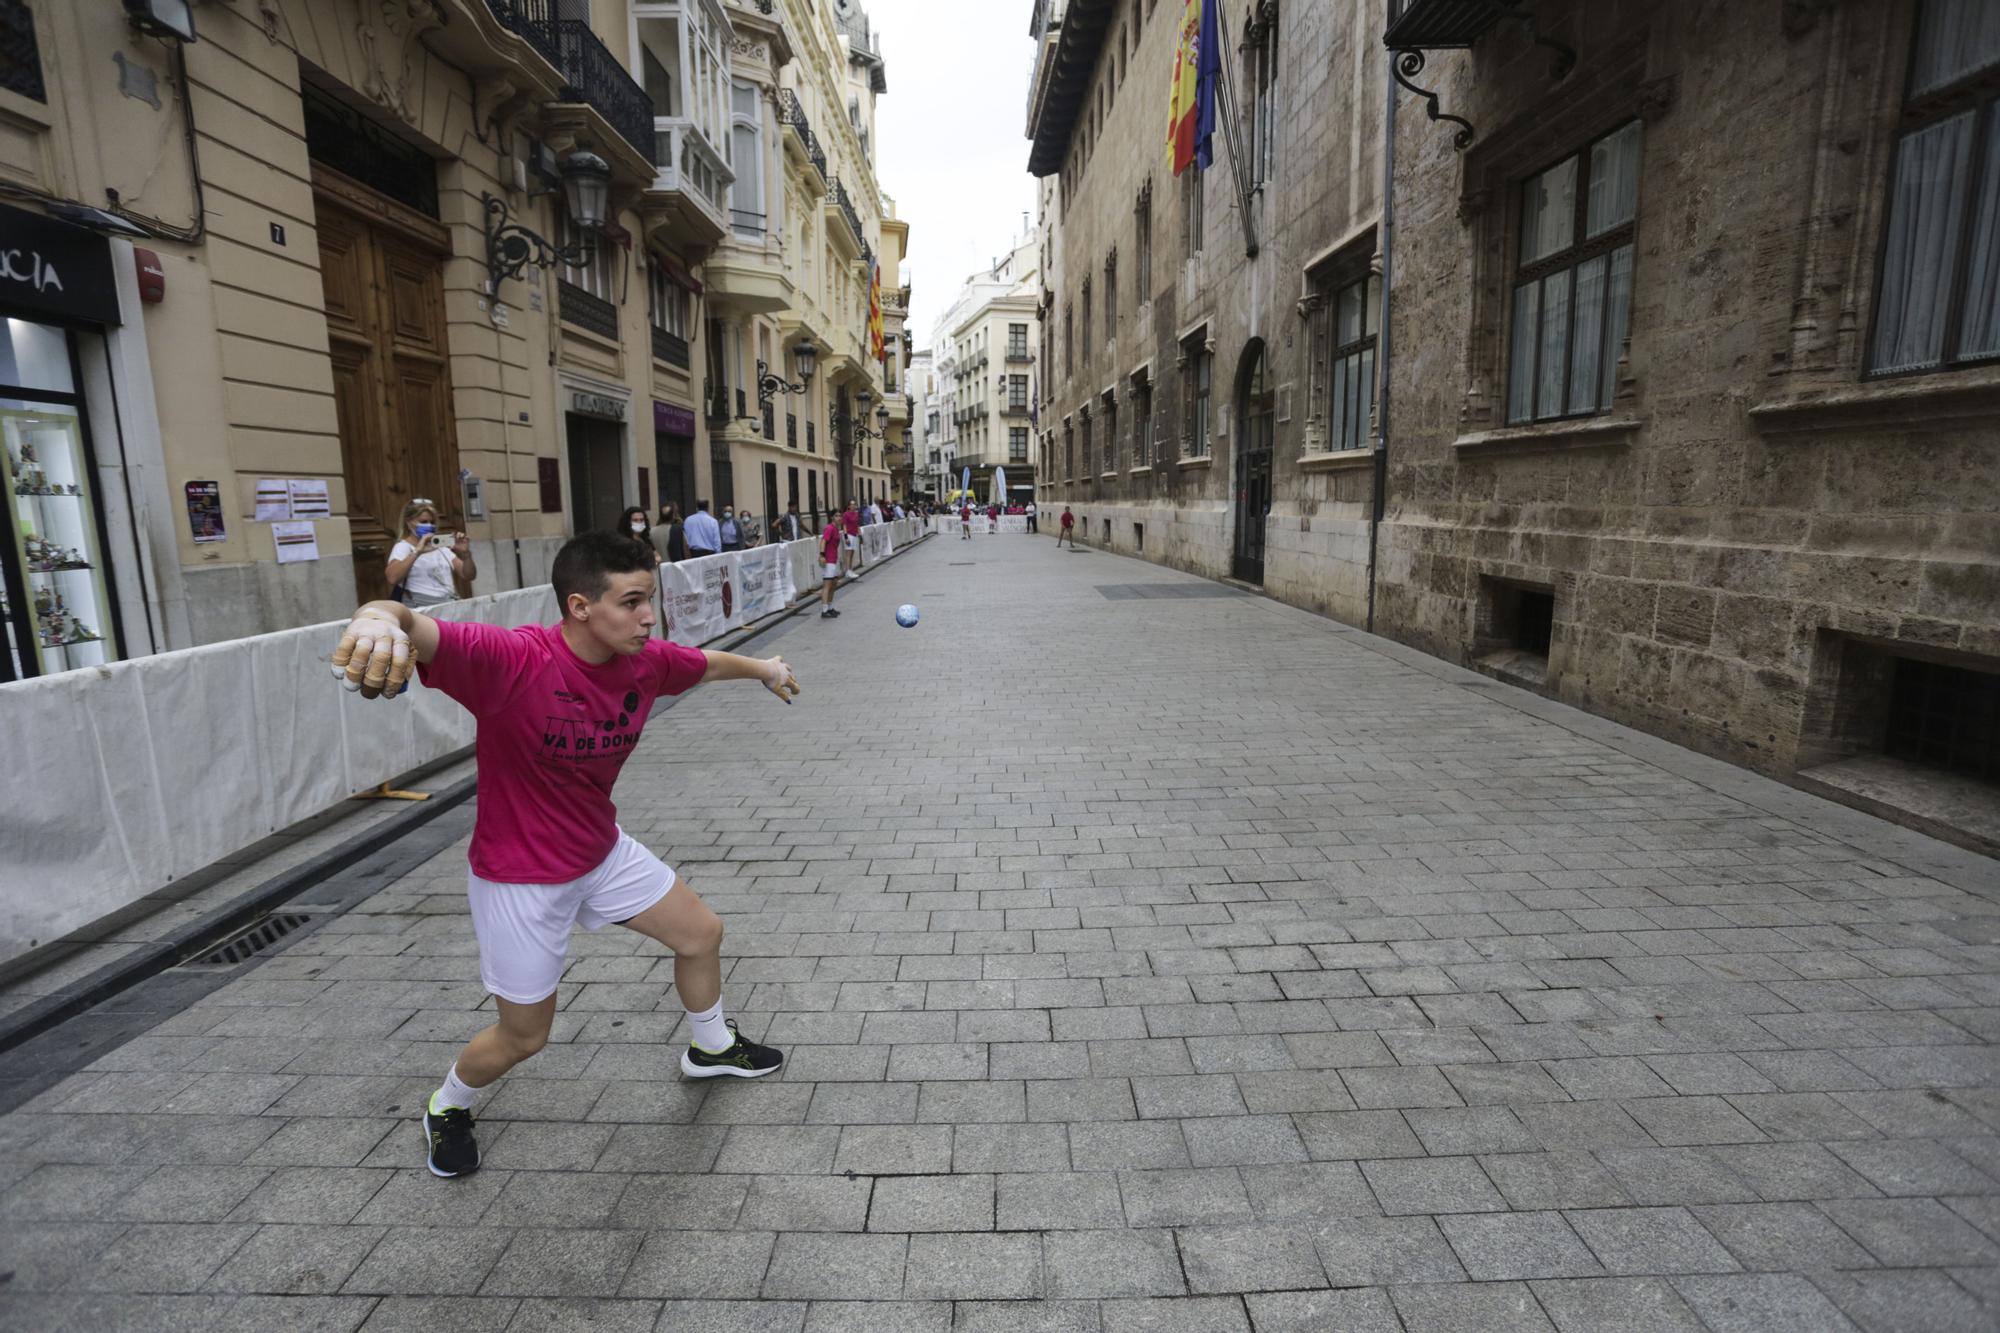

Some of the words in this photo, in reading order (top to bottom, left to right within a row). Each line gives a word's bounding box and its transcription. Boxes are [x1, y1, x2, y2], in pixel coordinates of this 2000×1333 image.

[273, 226, 281, 242] 7
[543, 733, 567, 749] VA
[575, 737, 596, 750] DE
